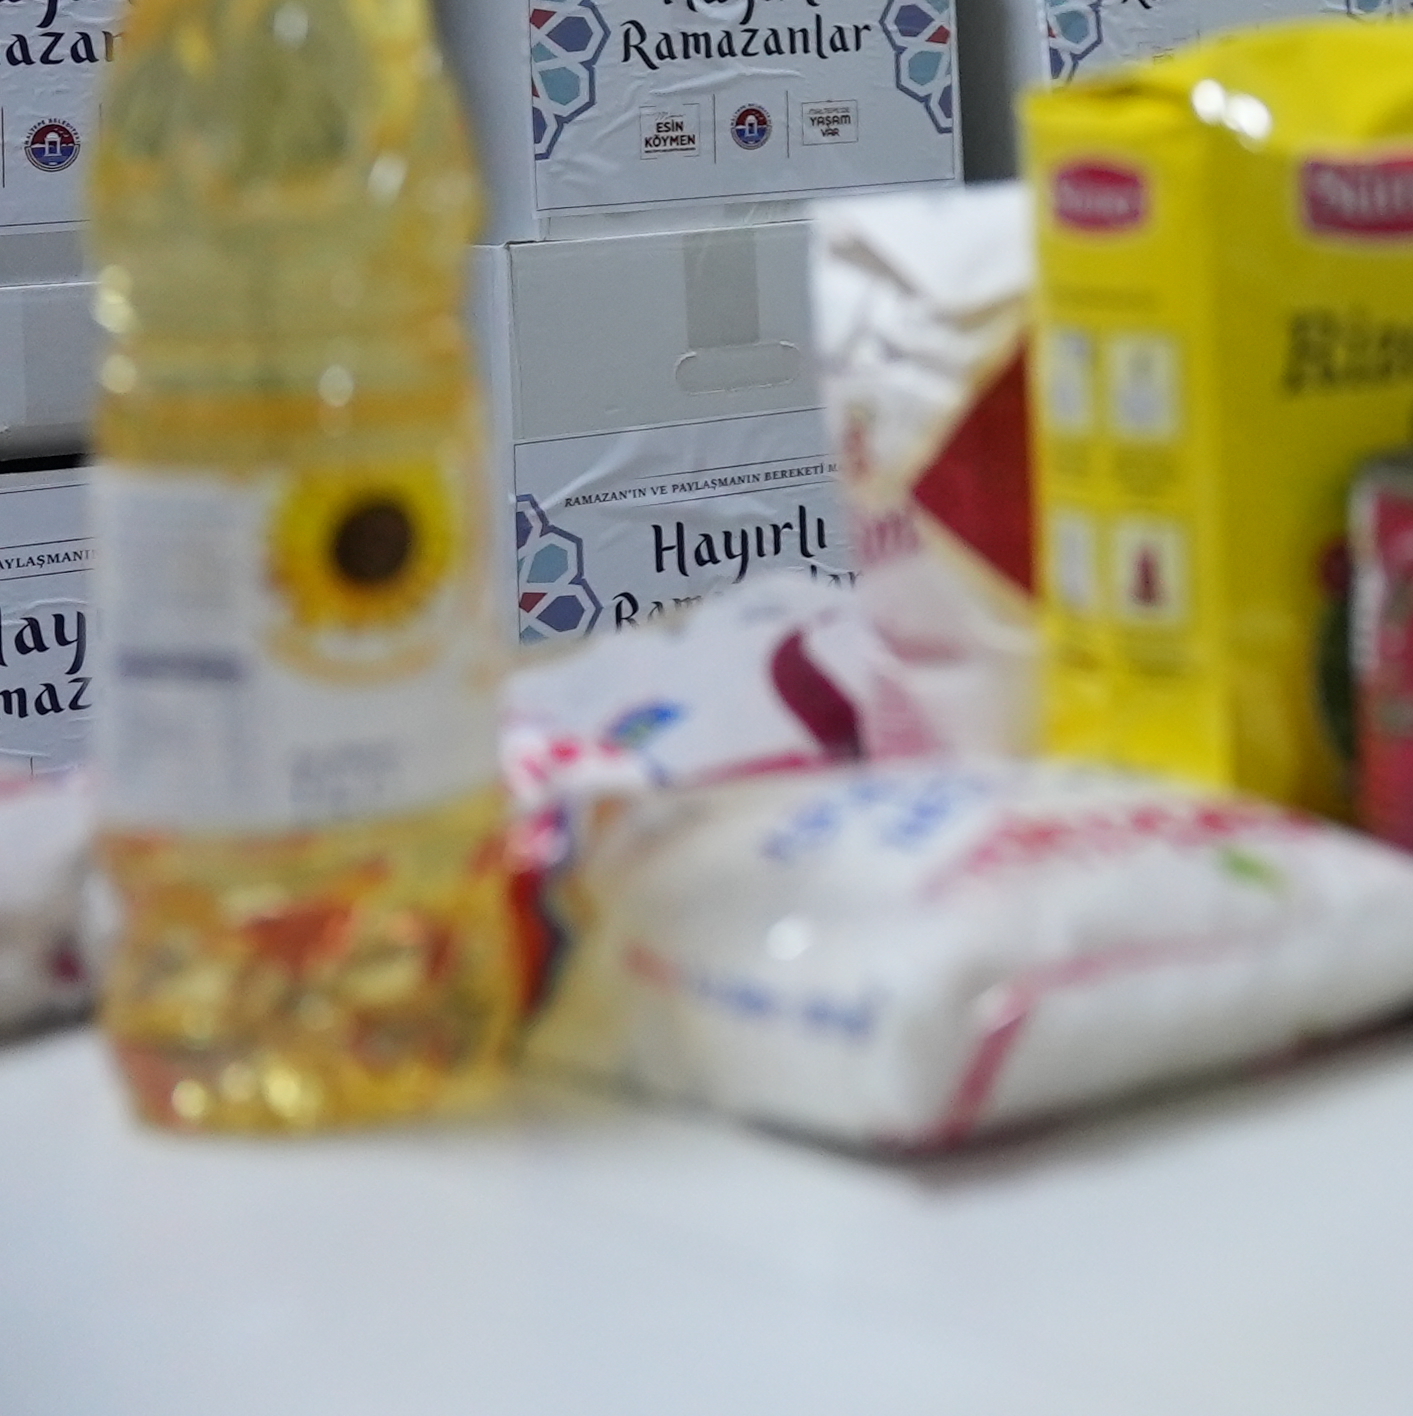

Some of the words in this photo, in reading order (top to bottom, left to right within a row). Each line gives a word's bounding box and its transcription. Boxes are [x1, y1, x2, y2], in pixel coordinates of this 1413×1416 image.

[620, 14, 872, 71] Ramazanlar
[656, 120, 684, 133] ESİN
[810, 115, 851, 128] YAŞAM
[820, 127, 841, 137] VAR
[644, 134, 696, 149] KÖYMEN
[565, 488, 647, 507] RAMAZAN'IN
[650, 484, 667, 496] VE
[672, 473, 761, 493] PAYLAŞMANIN
[764, 462, 824, 481] BEREKETİ
[652, 505, 828, 585] Hayırlı
